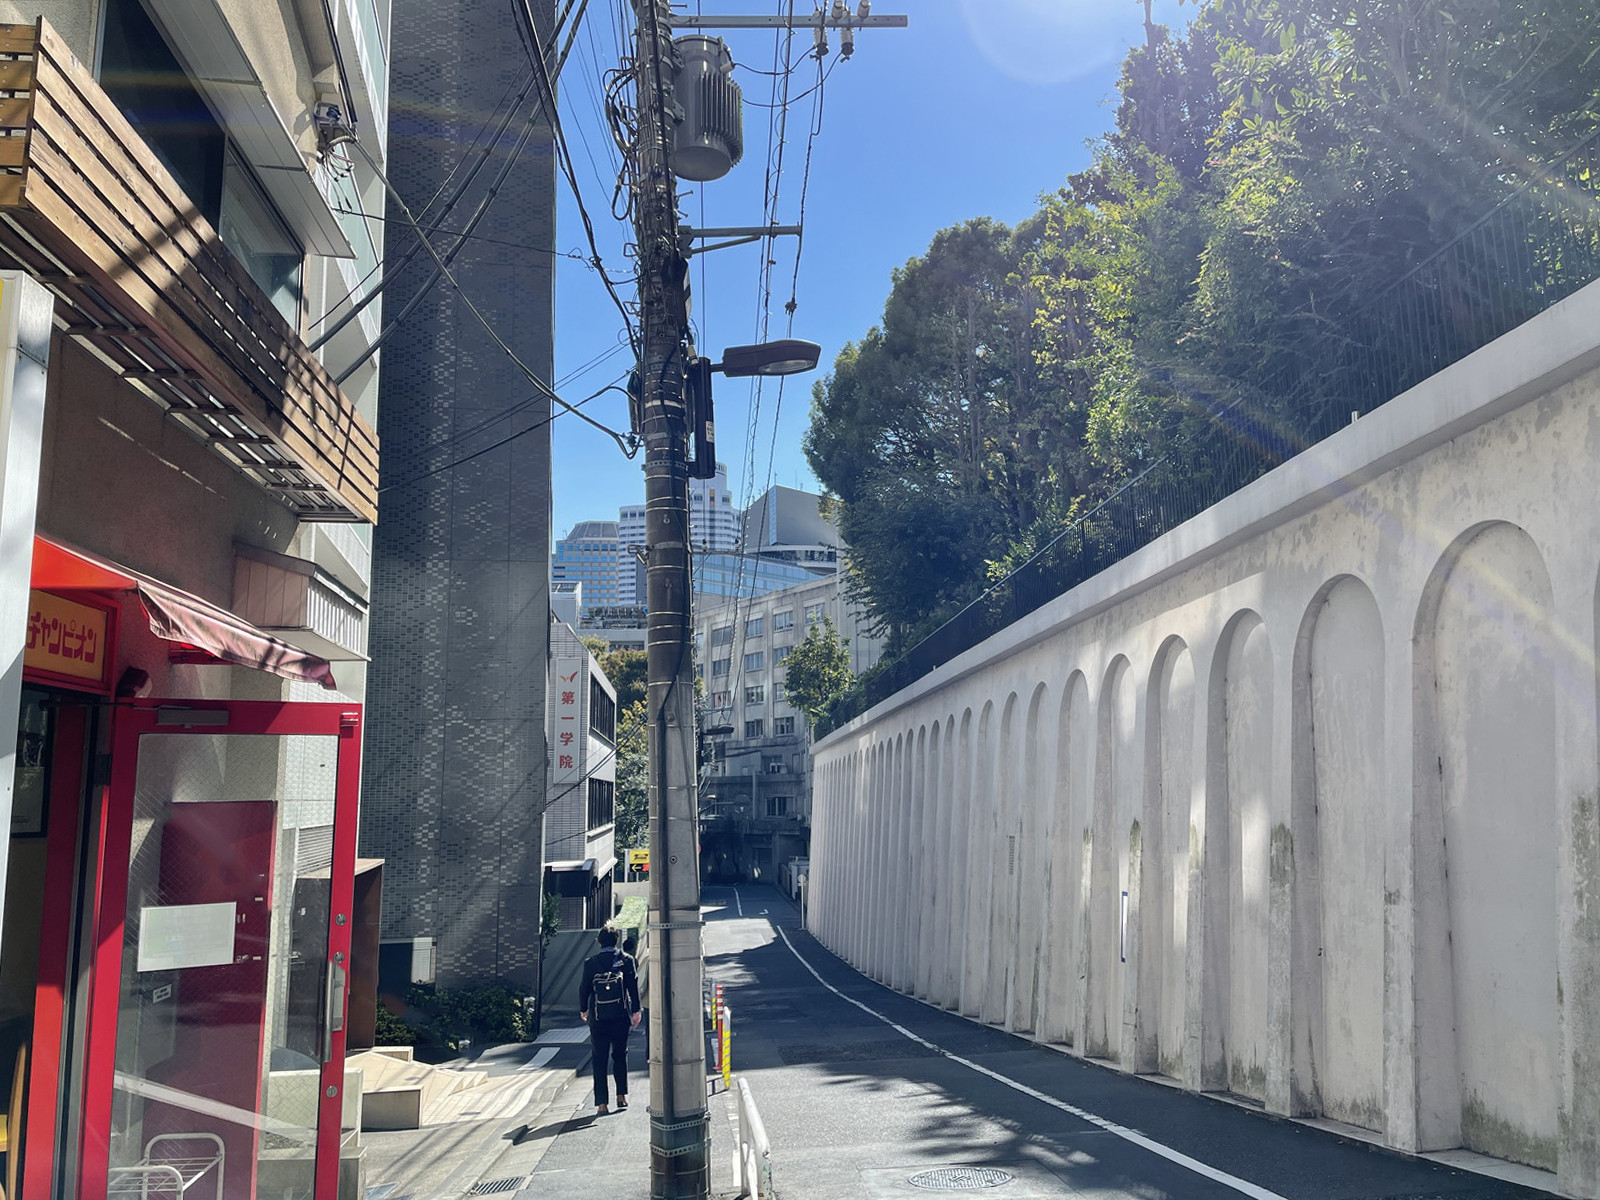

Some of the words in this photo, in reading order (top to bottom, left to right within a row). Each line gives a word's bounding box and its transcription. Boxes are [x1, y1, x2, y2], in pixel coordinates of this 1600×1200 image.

[27, 612, 97, 663] チャンピオン
[559, 691, 575, 769] 第一学院
